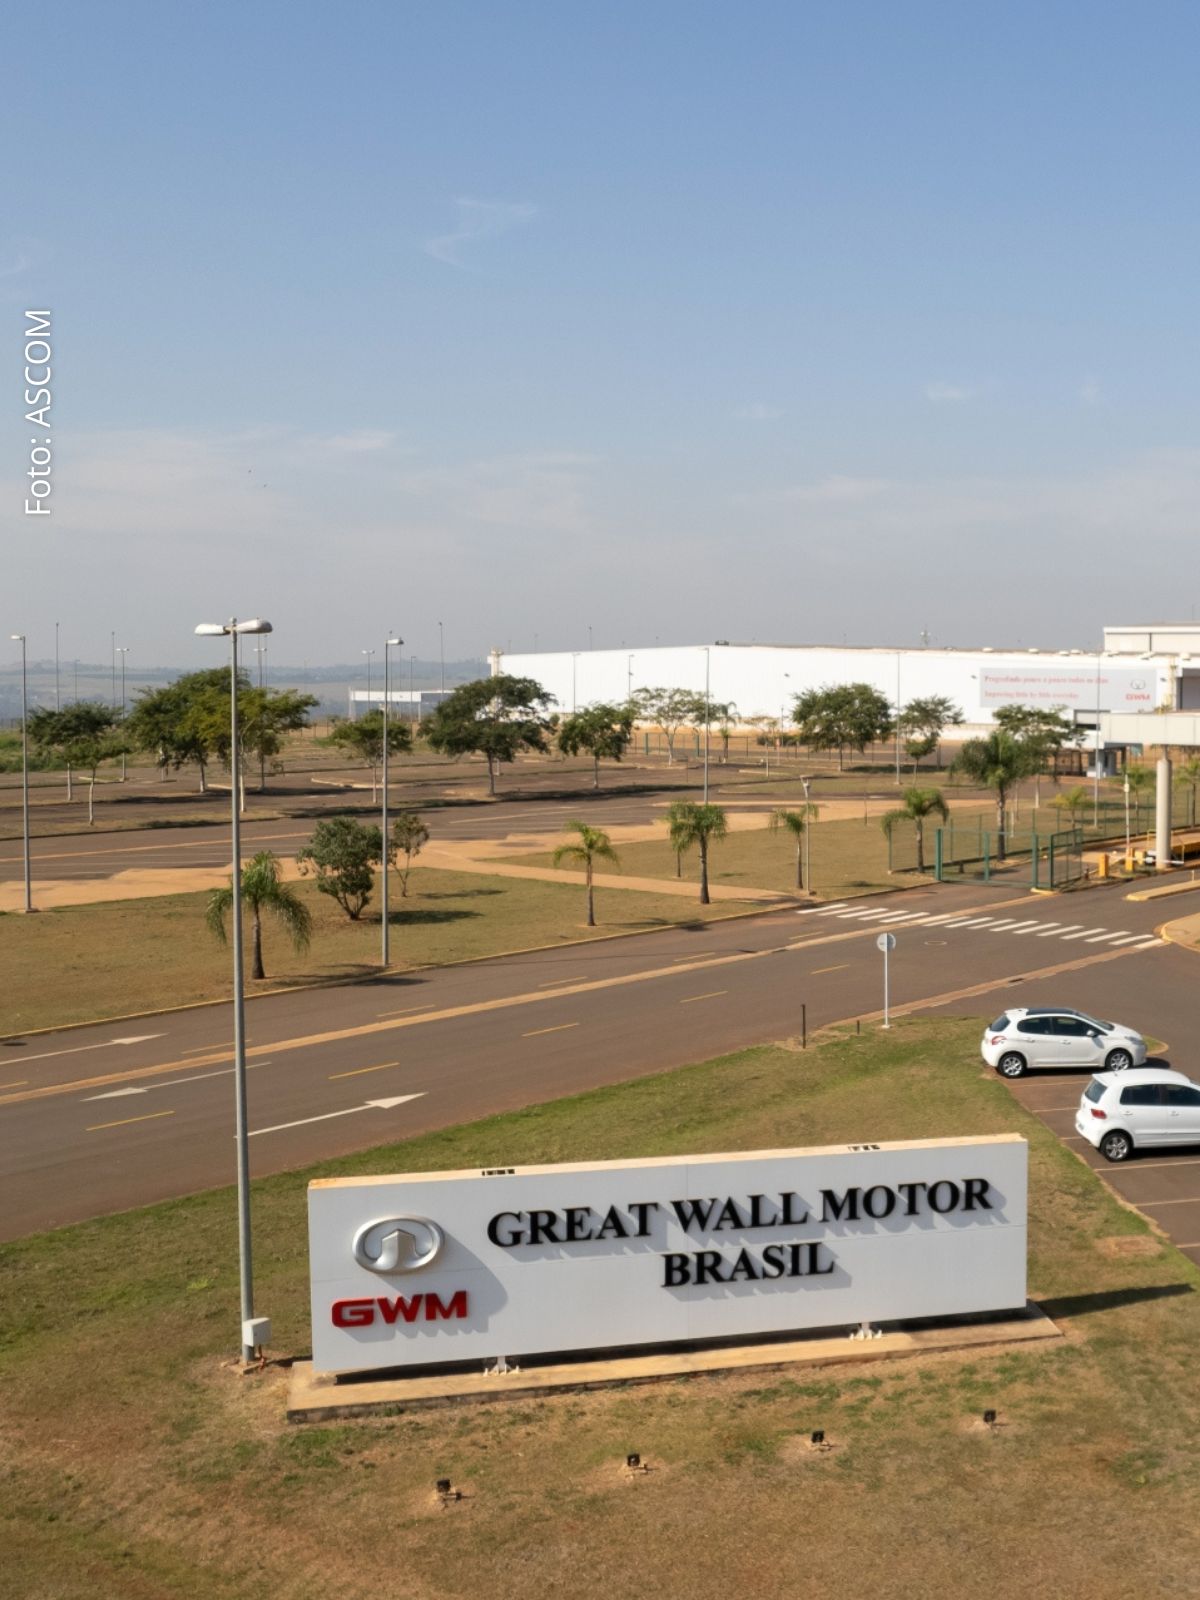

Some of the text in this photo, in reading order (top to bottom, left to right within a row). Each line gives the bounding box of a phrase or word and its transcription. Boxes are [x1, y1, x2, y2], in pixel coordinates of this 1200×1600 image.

[488, 1179, 993, 1247] GREAT WALL MOTOR
[663, 1242, 834, 1287] BRASIL
[331, 1292, 468, 1327] GWM
